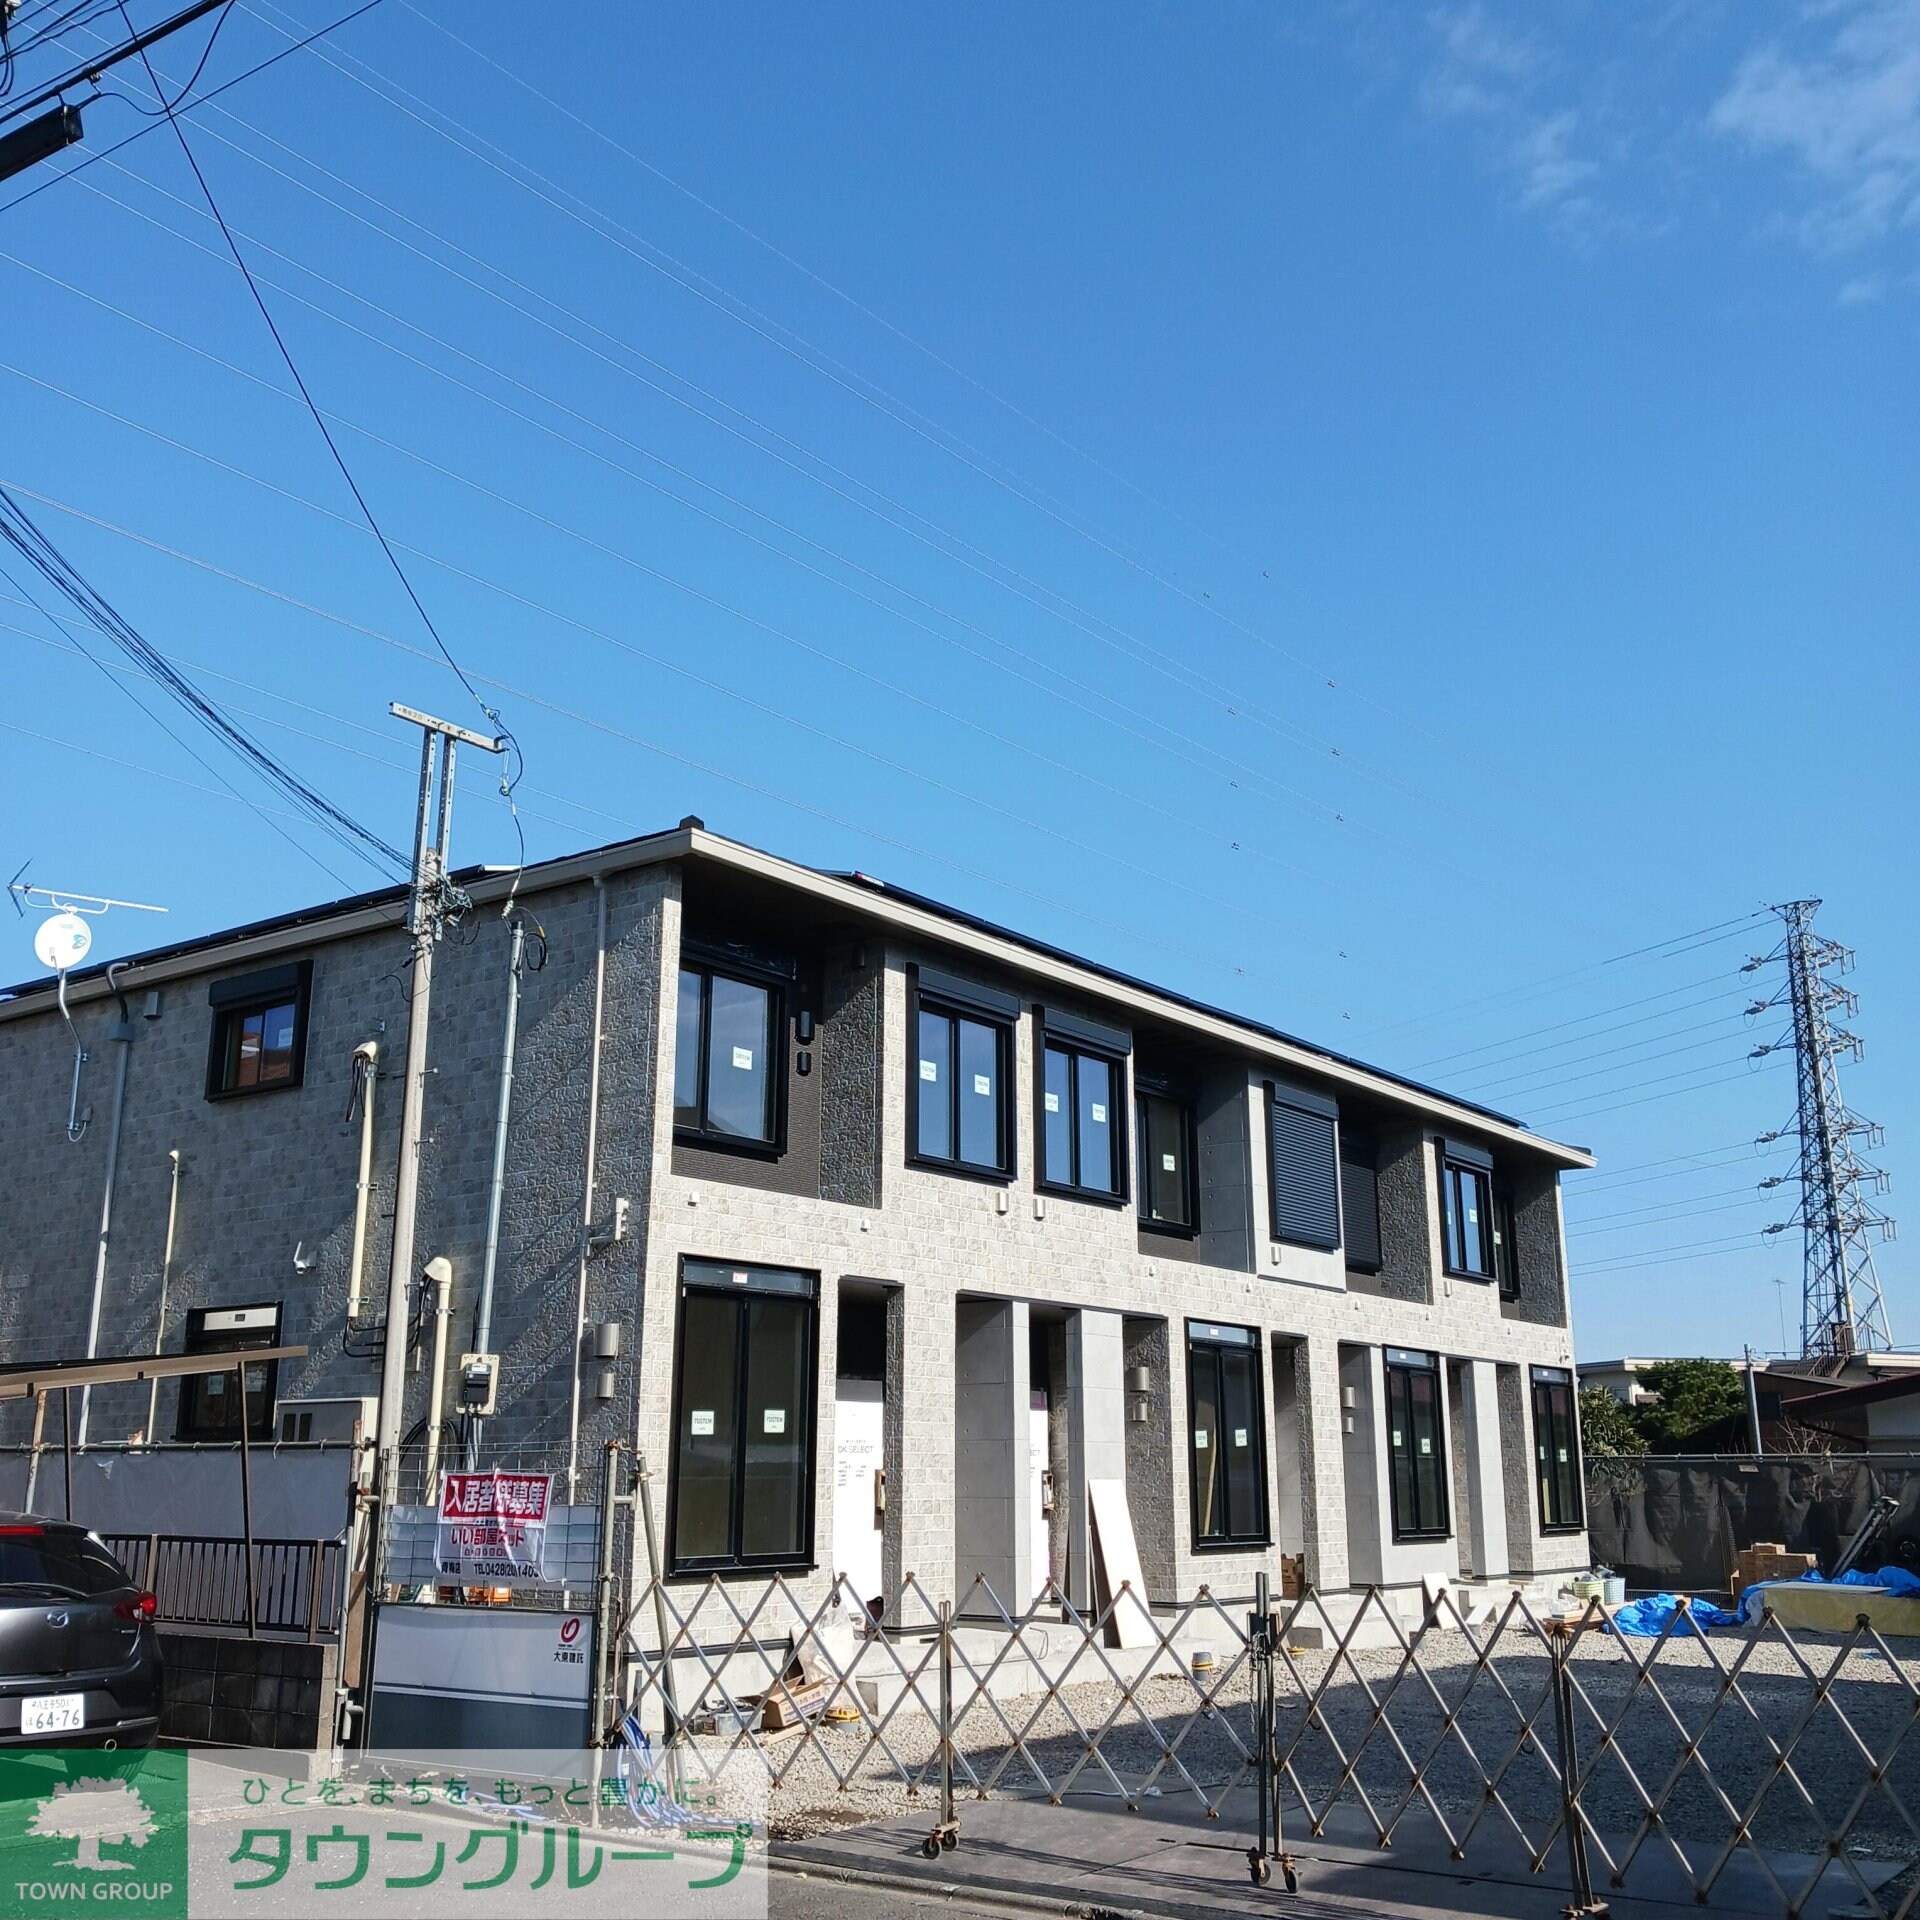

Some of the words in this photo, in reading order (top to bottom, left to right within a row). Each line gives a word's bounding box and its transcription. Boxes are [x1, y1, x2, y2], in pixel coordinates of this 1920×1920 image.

[451, 1527, 525, 1547] いい部屋ネット
[36, 1709, 80, 1729] 64-76
